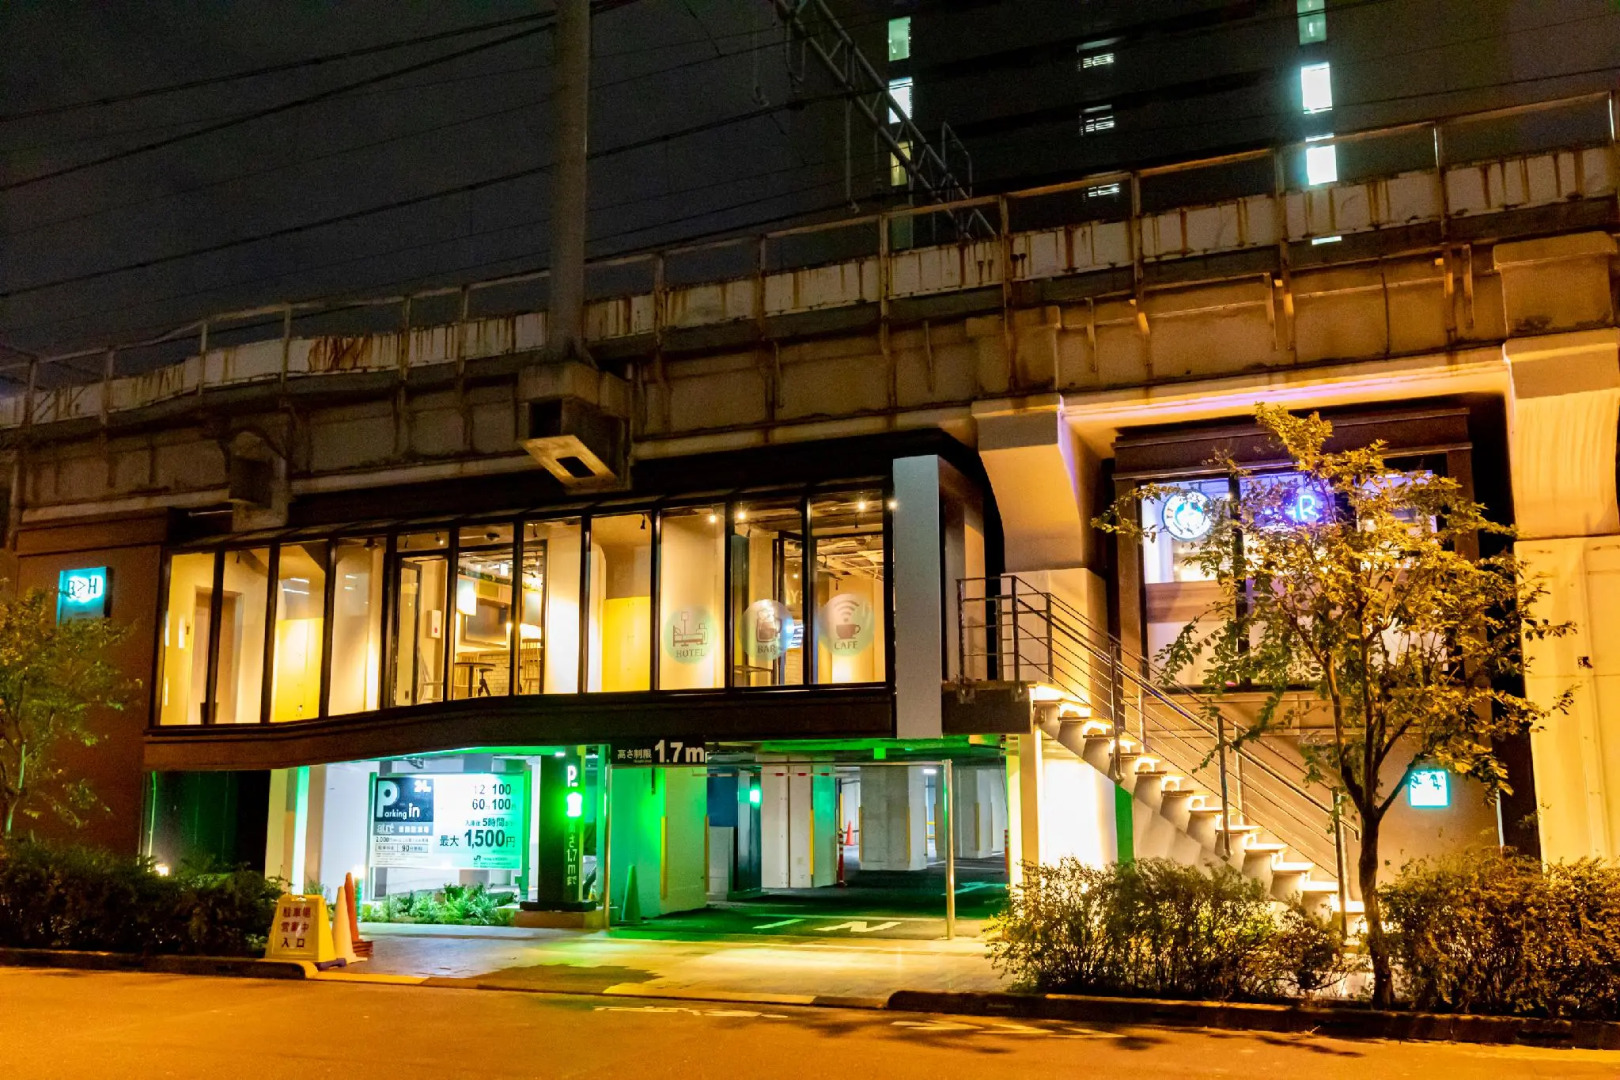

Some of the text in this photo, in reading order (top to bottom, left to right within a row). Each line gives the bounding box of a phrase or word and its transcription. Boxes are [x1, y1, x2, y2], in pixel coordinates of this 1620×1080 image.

[834, 640, 859, 650] CAFE
[676, 649, 705, 658] HOTEL
[654, 739, 705, 763] 1.7m
[408, 802, 420, 818] in
[439, 834, 460, 847] 最大
[281, 937, 305, 948] 入口
